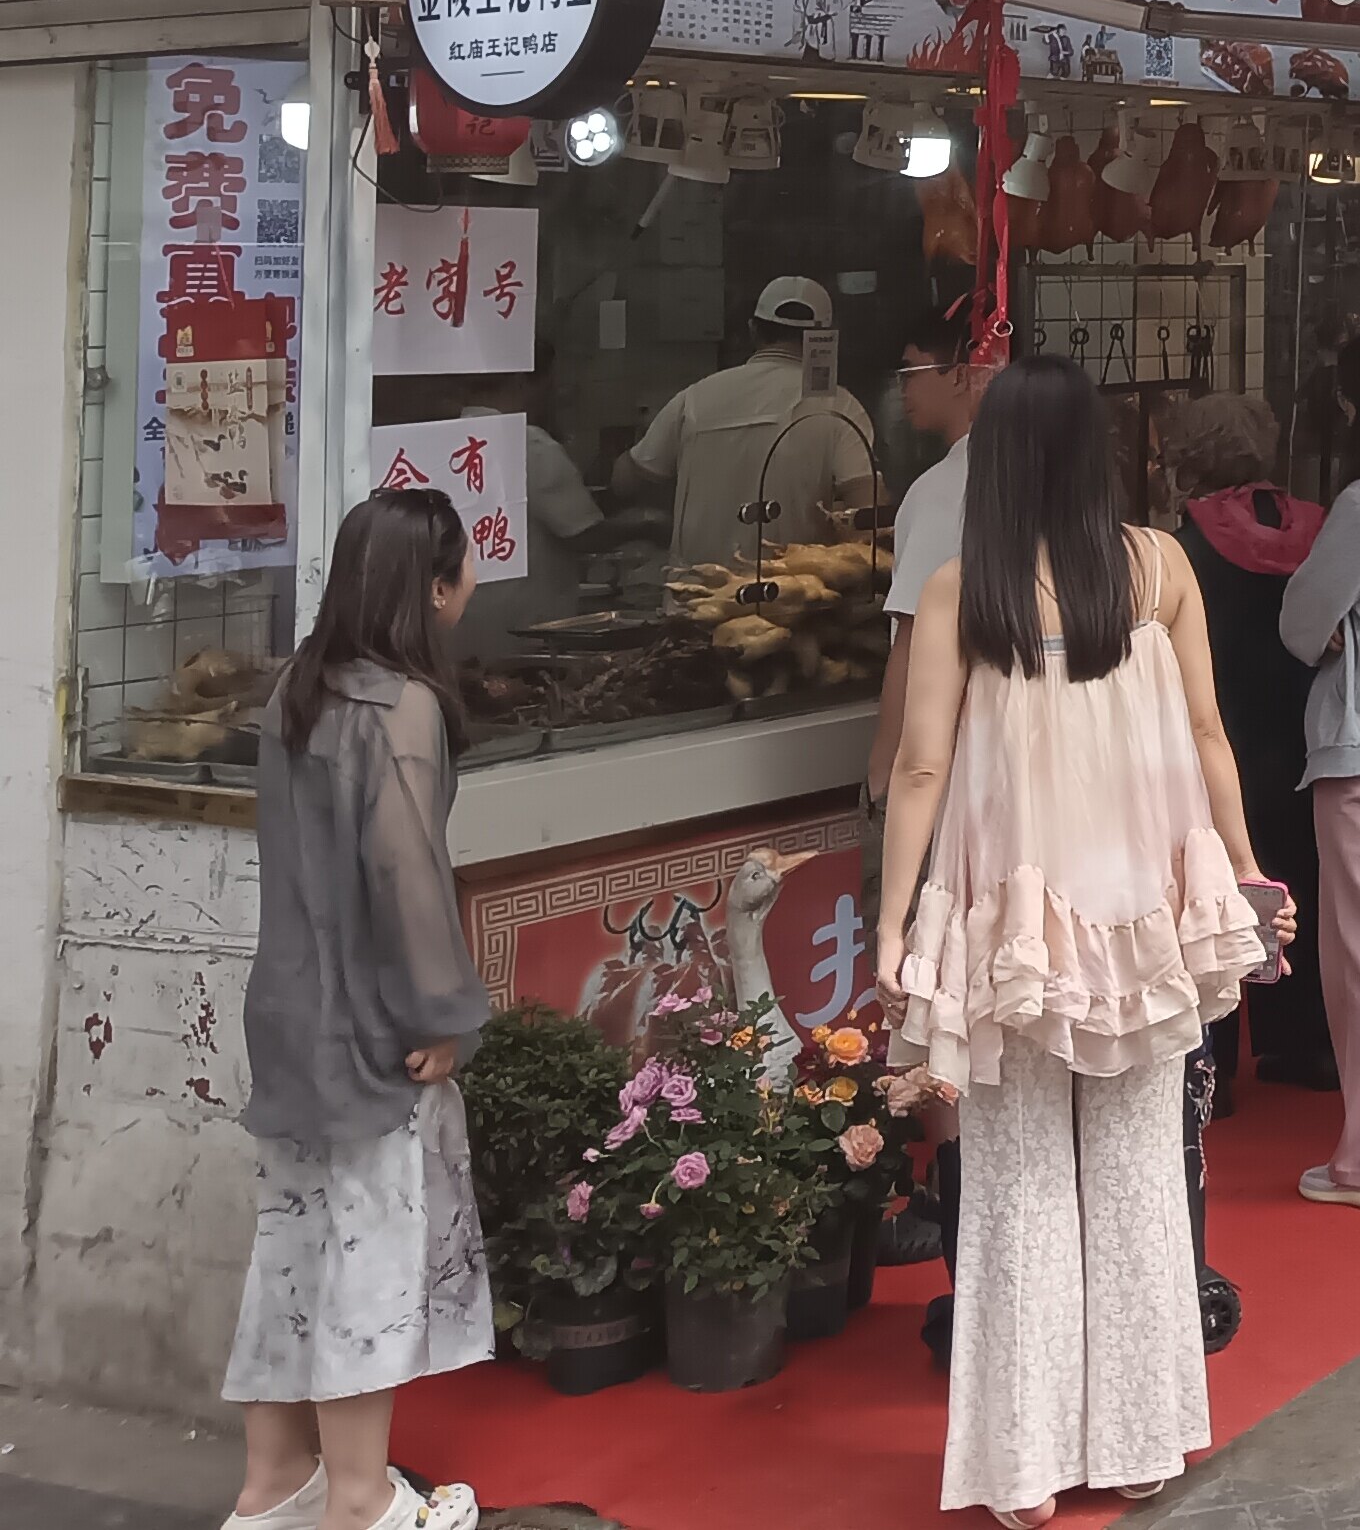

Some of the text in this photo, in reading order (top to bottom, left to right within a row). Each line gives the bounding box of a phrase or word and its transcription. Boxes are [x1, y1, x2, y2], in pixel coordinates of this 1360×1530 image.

[449, 32, 559, 61] 红庙王记鸭店
